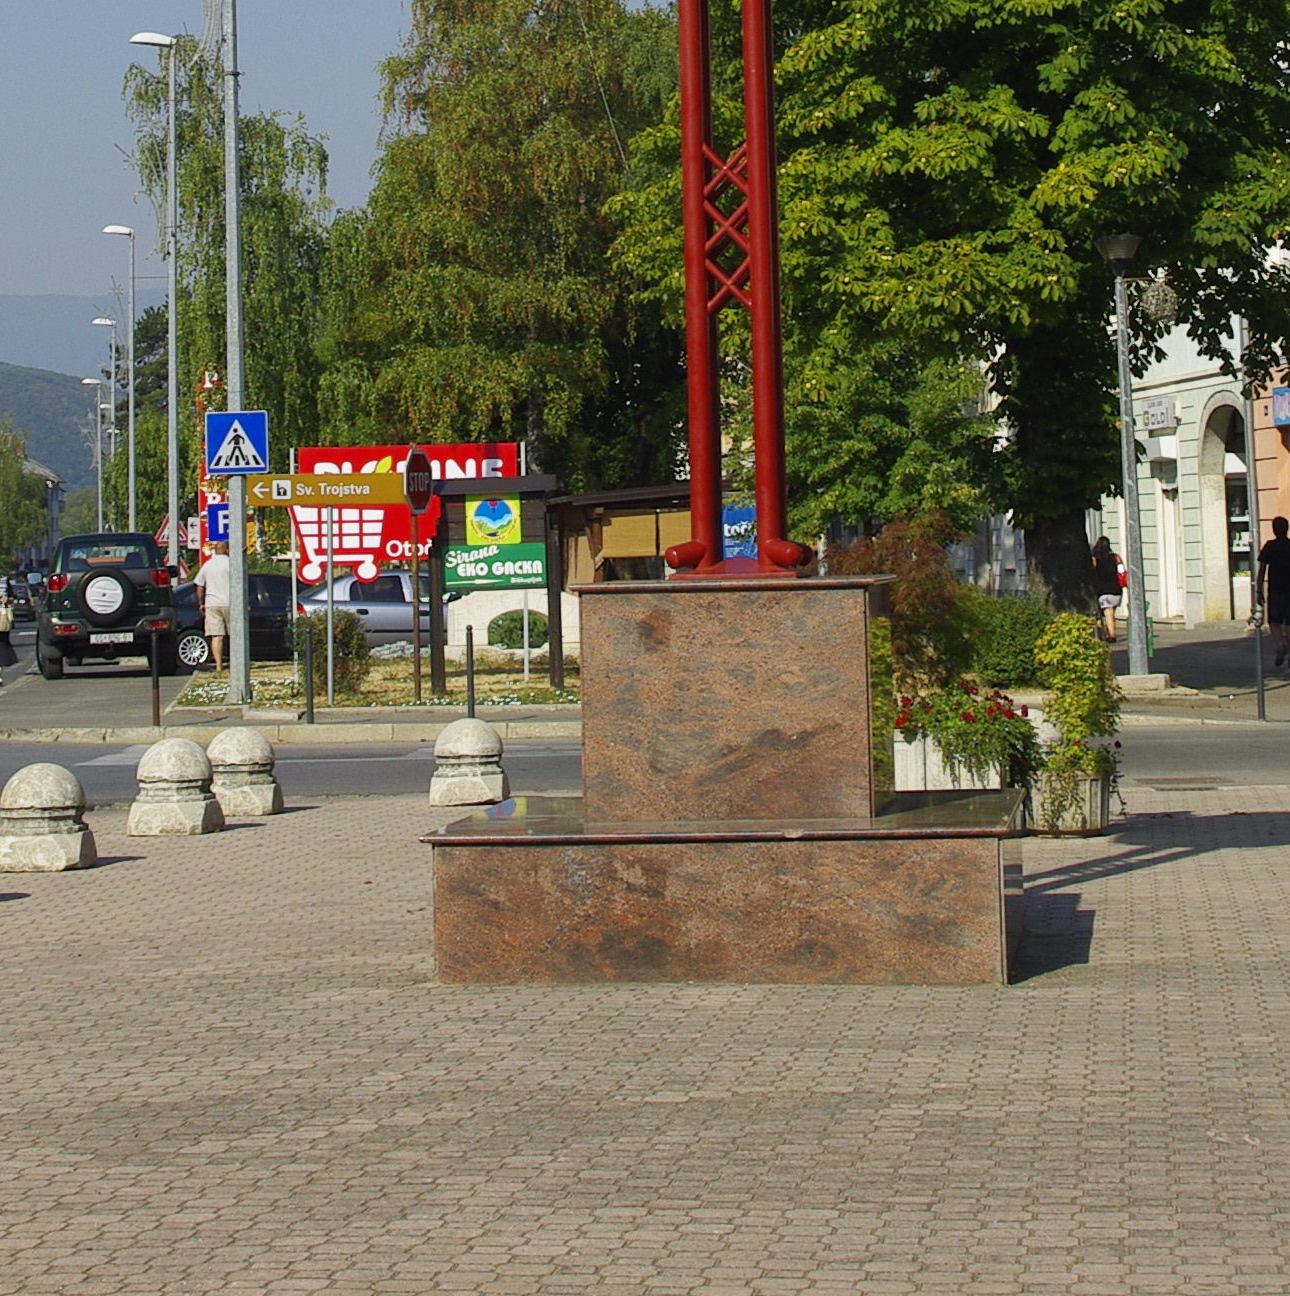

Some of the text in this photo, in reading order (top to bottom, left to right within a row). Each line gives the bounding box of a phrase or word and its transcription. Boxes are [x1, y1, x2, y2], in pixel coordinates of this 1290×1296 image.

[296, 482, 370, 497] Sv. Trojstva
[409, 472, 430, 492] STOP
[457, 560, 543, 577] EKO GACKA
